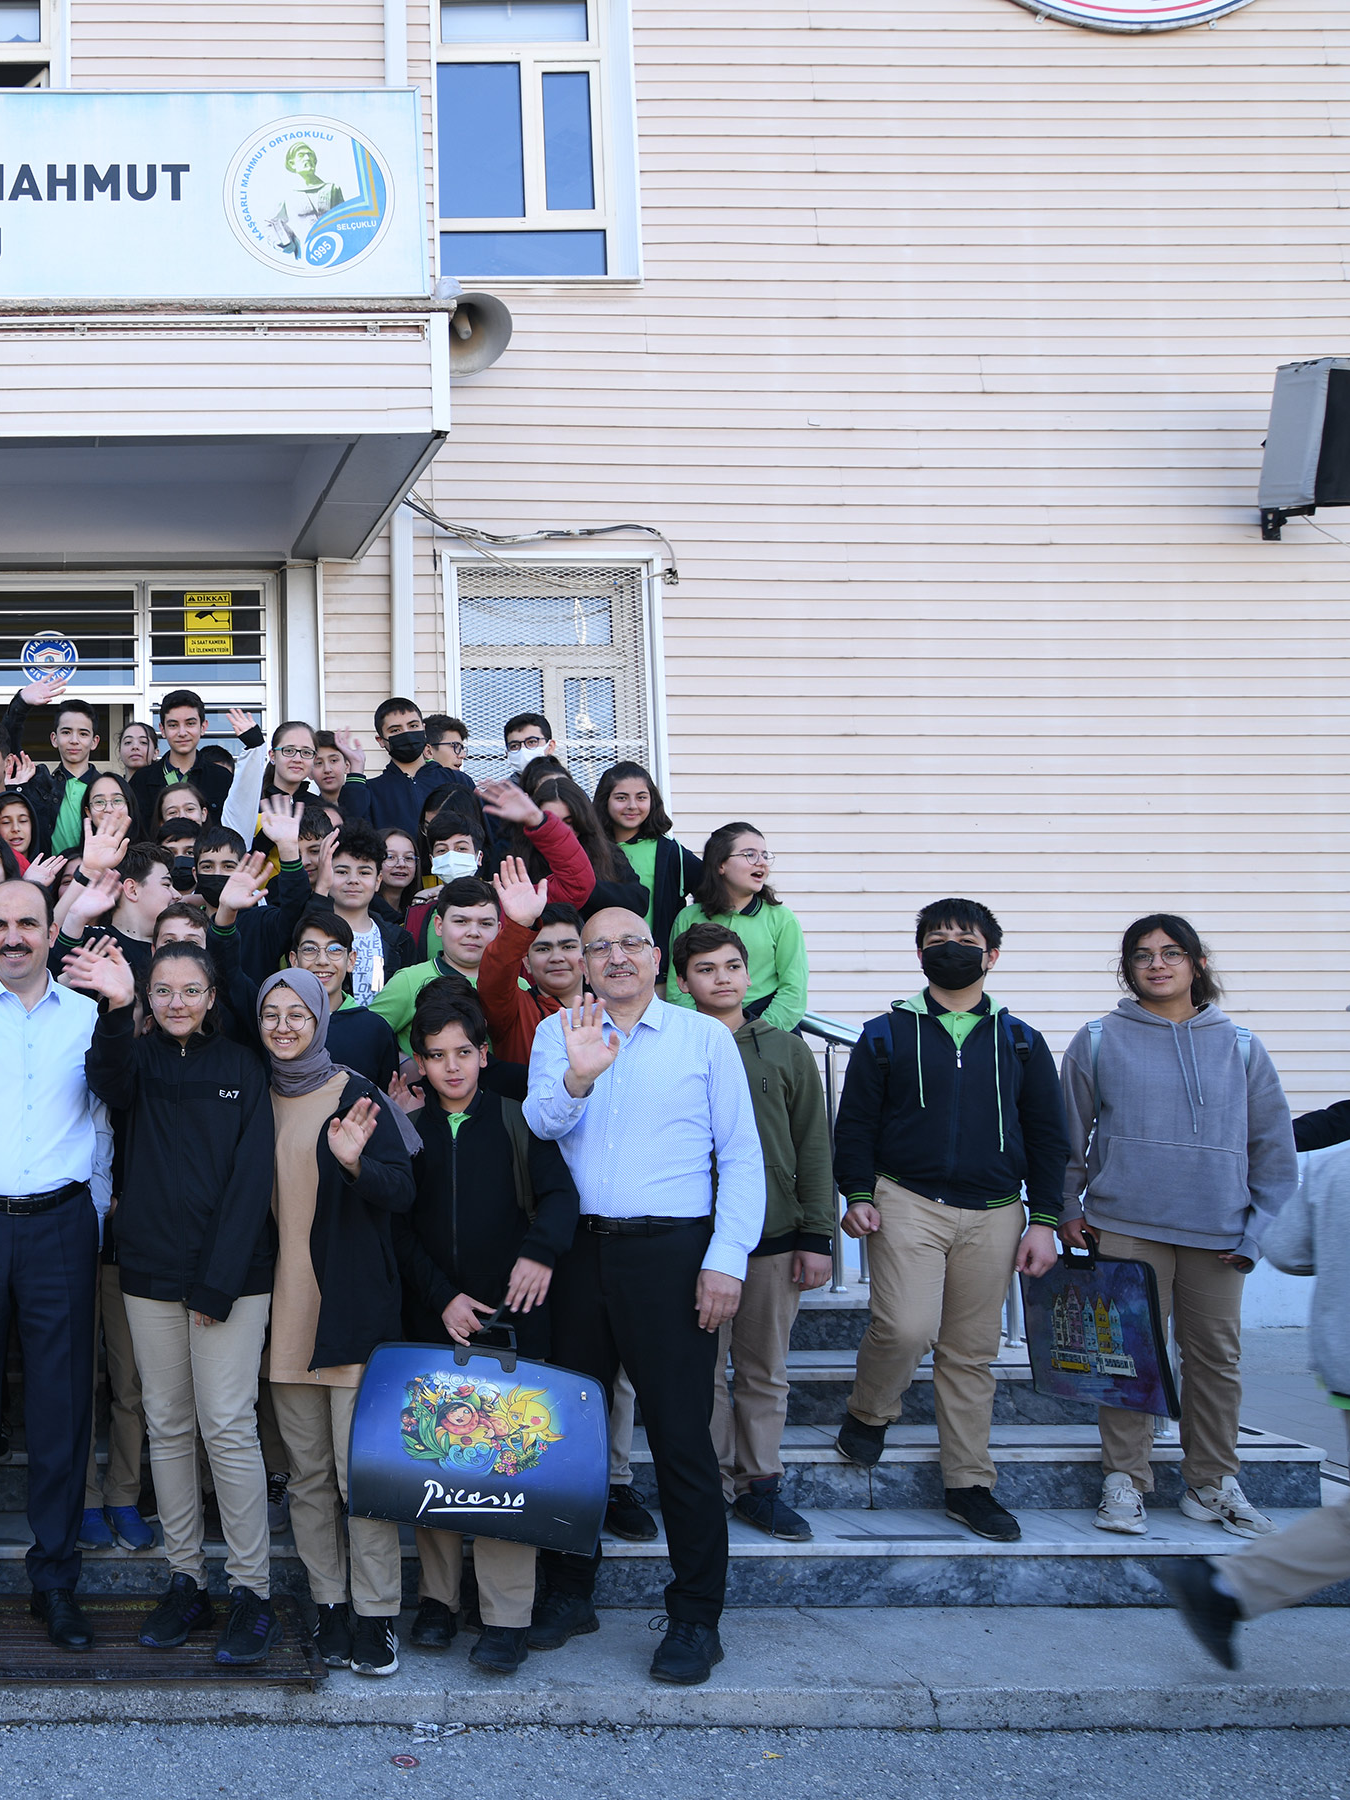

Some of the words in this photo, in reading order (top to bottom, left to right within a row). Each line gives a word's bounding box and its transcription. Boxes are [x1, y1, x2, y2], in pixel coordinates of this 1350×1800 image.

[268, 130, 334, 148] ORTAOKULU
[240, 146, 267, 188] MAHMUT
[239, 190, 265, 241] KAŞGARLI
[336, 220, 377, 231] SELÇUKLU
[309, 240, 332, 262] 1995
[218, 1089, 240, 1099] EA7
[415, 1479, 525, 1518] Picasso
